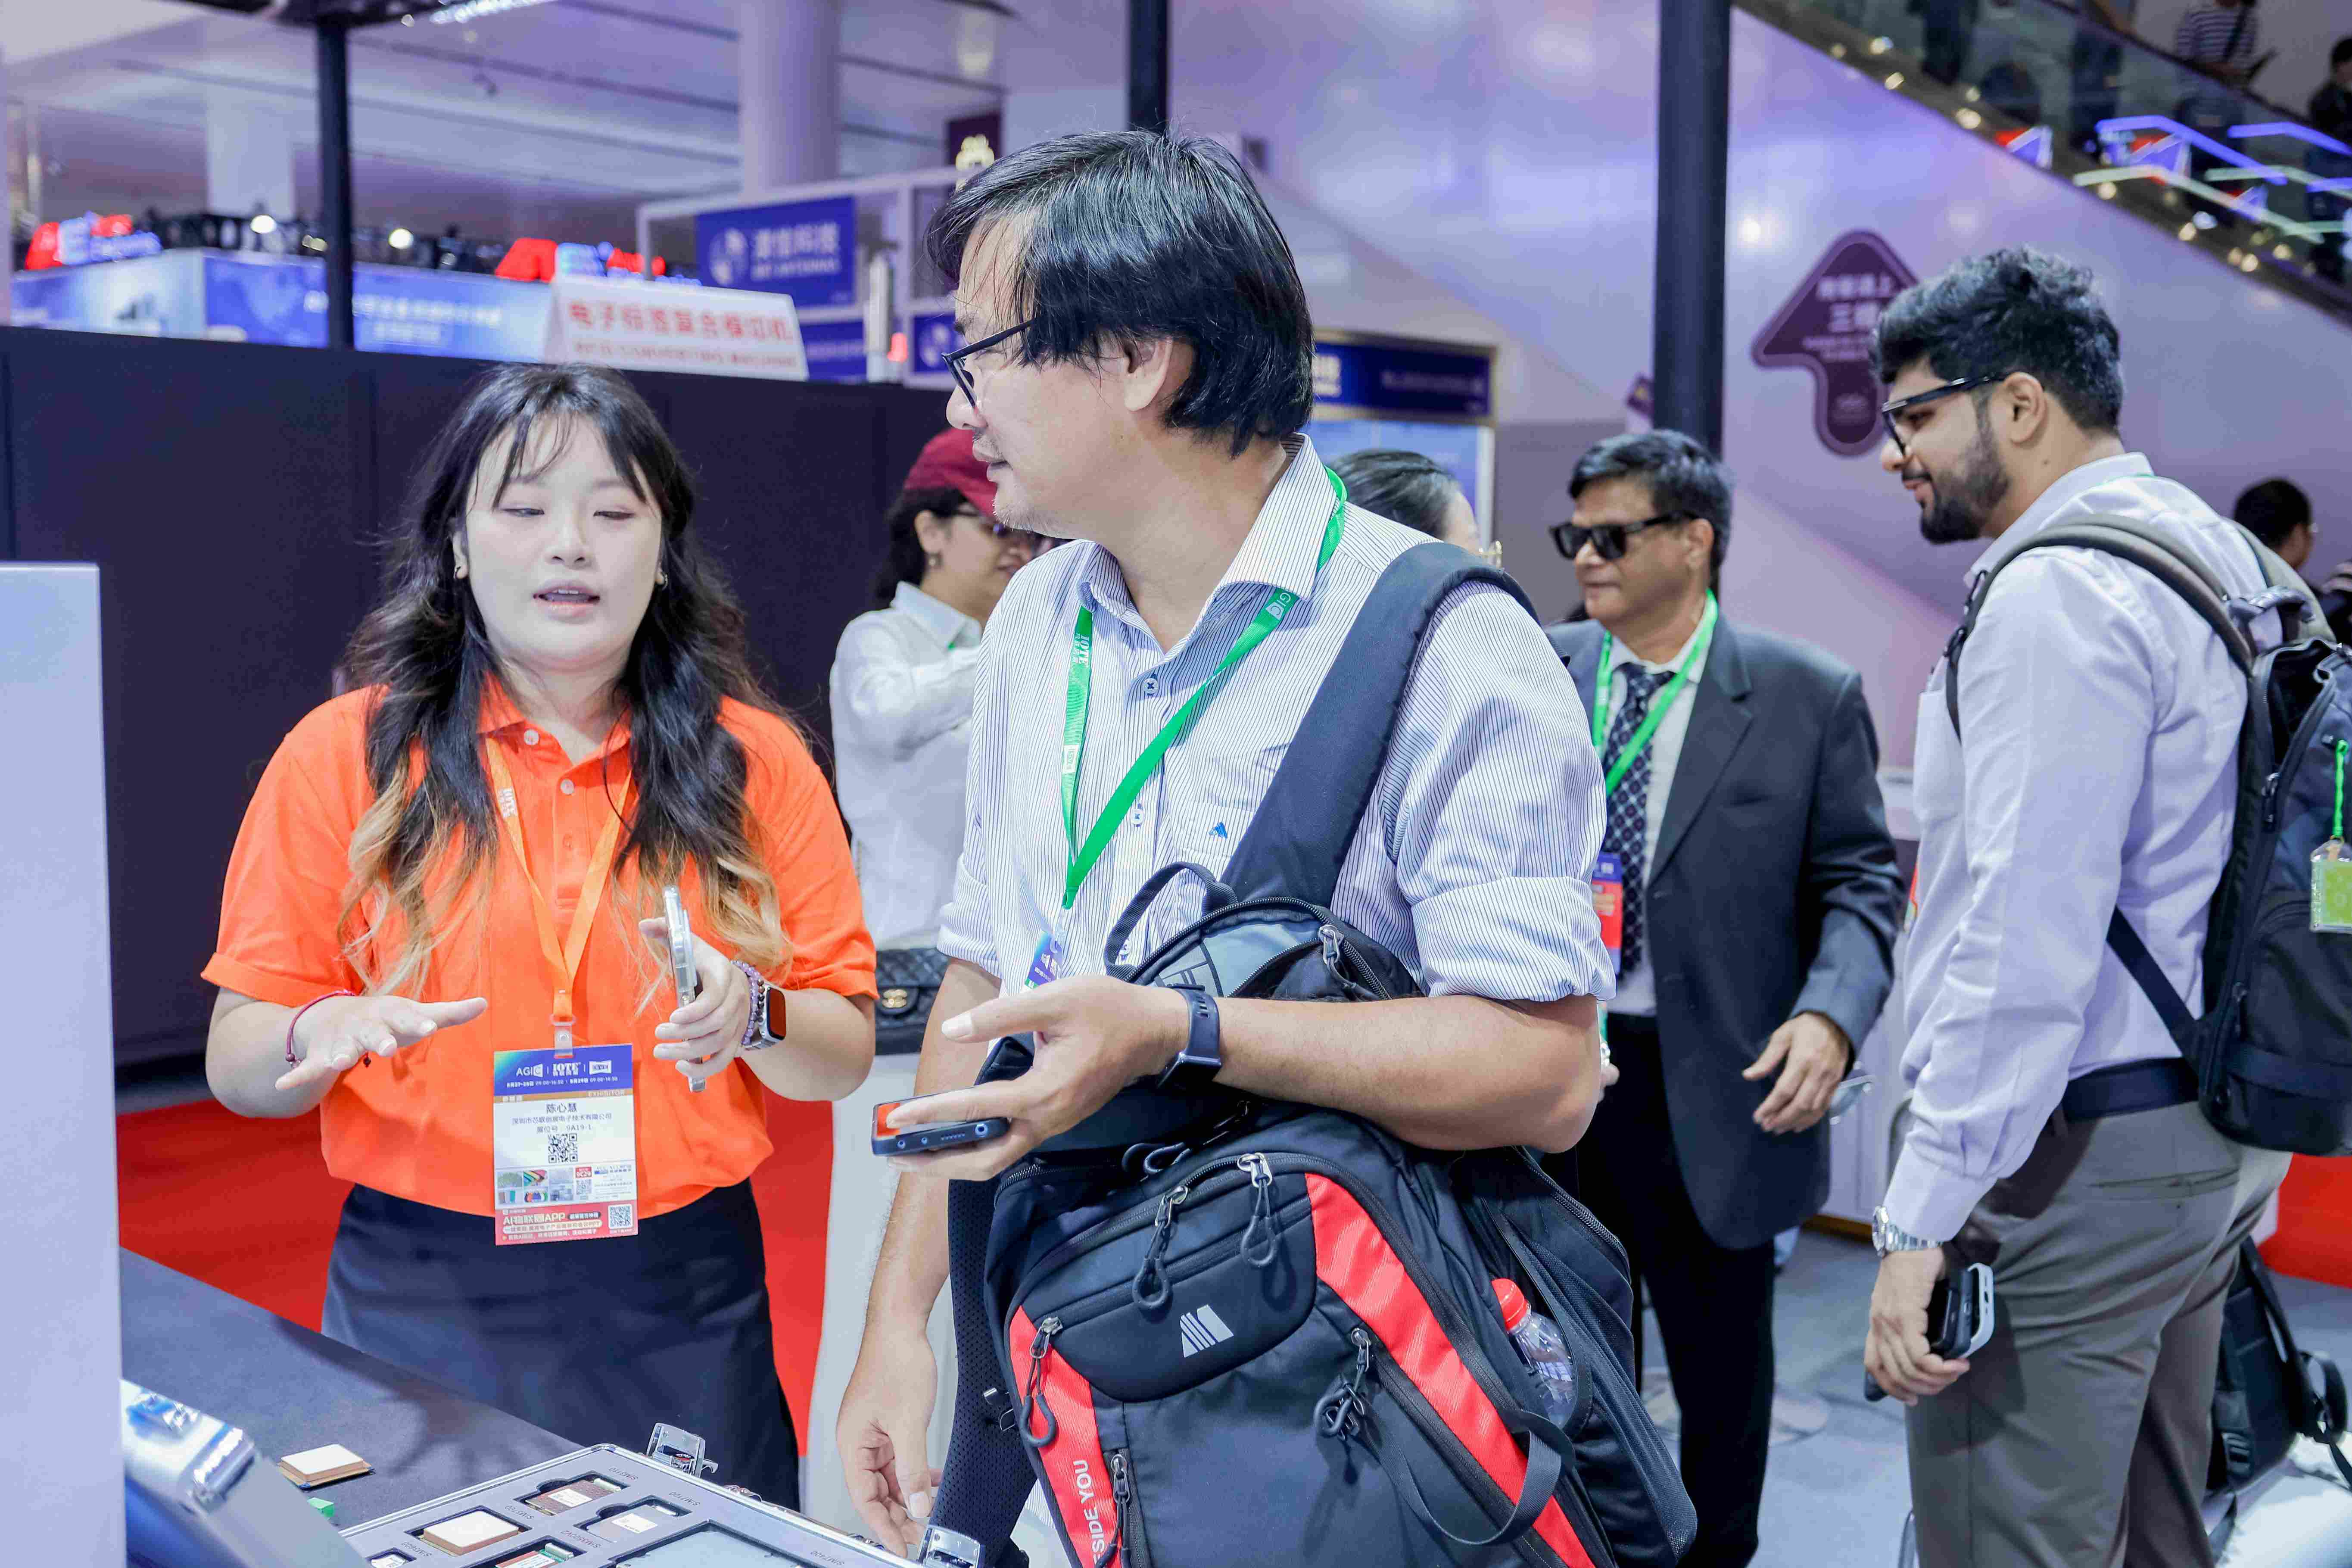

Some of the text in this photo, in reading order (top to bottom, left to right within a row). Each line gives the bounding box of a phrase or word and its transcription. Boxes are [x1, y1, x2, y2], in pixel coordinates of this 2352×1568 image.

[1265, 592, 1291, 620] GIC
[516, 1063, 543, 1077] AGIC
[1073, 1460, 1094, 1504] YOU
